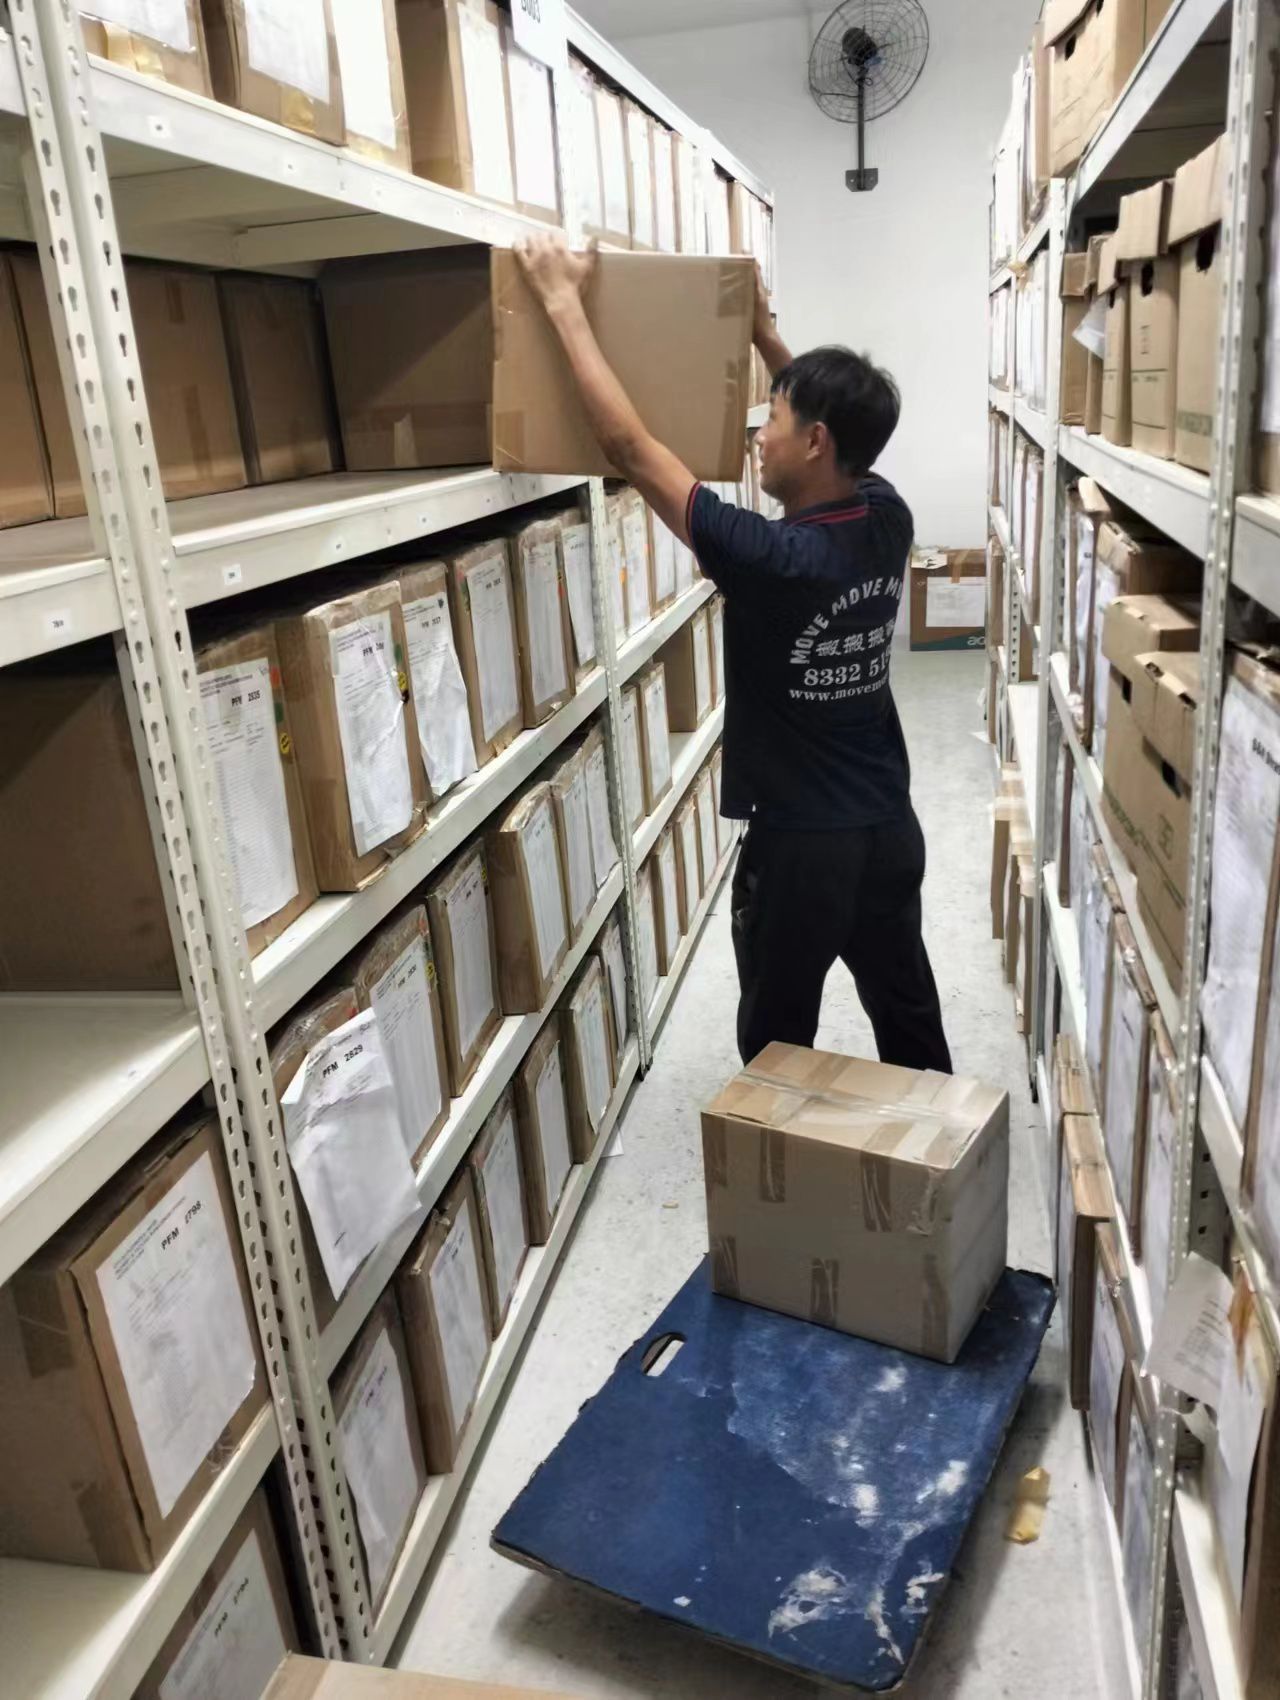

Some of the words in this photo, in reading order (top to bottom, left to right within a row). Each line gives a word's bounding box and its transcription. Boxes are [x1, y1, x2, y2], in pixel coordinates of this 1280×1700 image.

[789, 613, 830, 665] MOVE
[831, 577, 884, 616] MOVE
[803, 663, 862, 686] 8332
[322, 1061, 339, 1079] PFM
[161, 1226, 180, 1251] PFM
